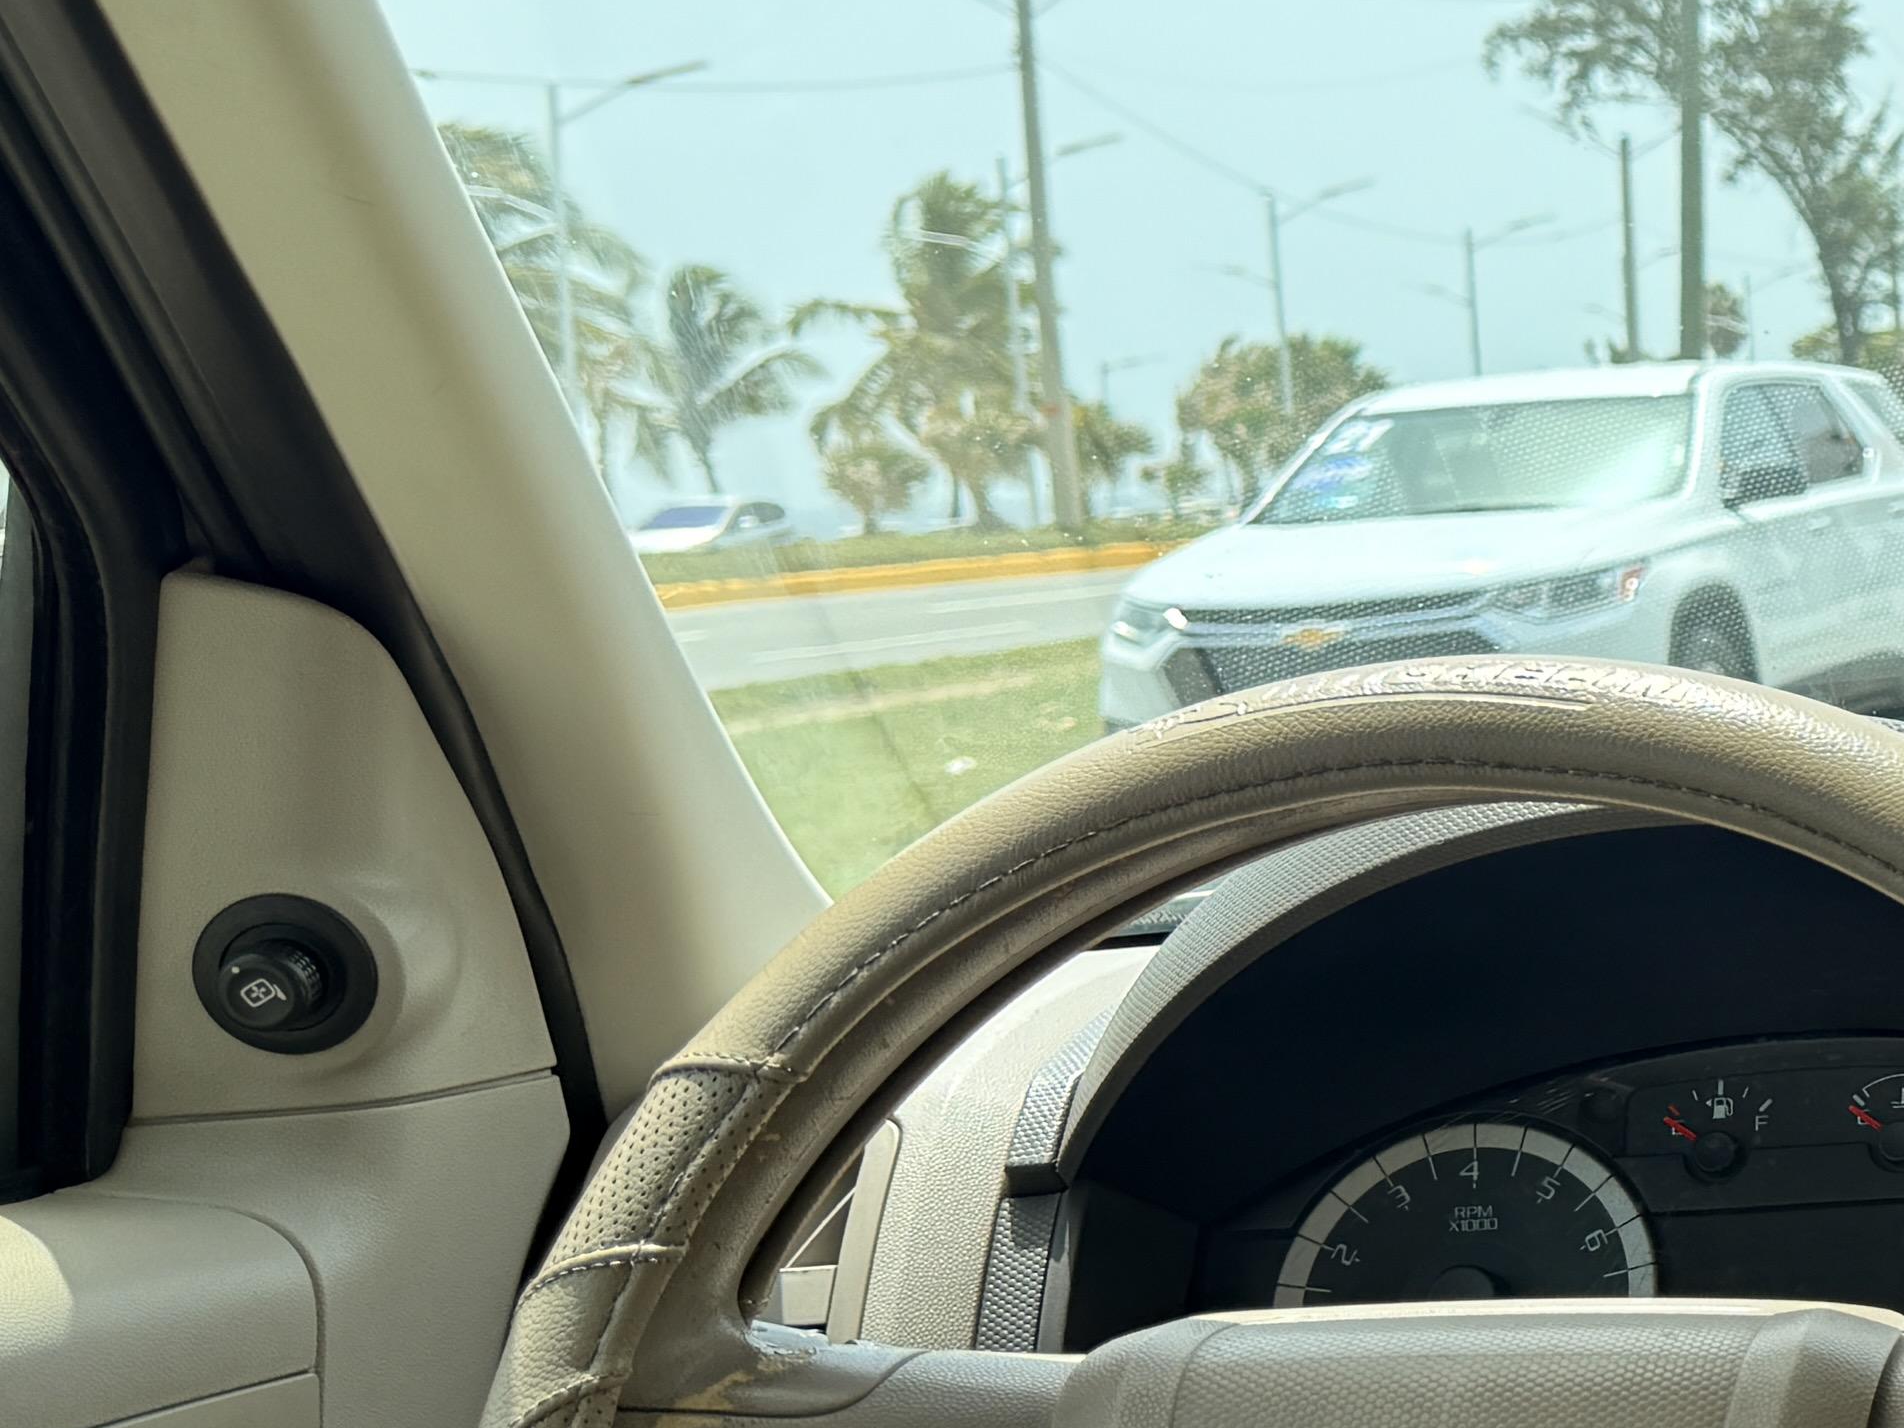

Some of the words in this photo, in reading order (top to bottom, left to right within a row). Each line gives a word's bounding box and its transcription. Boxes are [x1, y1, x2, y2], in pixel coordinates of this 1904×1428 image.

[1754, 1114, 1770, 1132] F
[1459, 1160, 1480, 1182] 4
[1388, 1185, 1412, 1209] 3
[1538, 1176, 1562, 1201] 5
[1454, 1204, 1493, 1218] RPM
[1448, 1218, 1498, 1233] X1000
[1584, 1228, 1609, 1253] 6
[1331, 1243, 1354, 1267] 2
